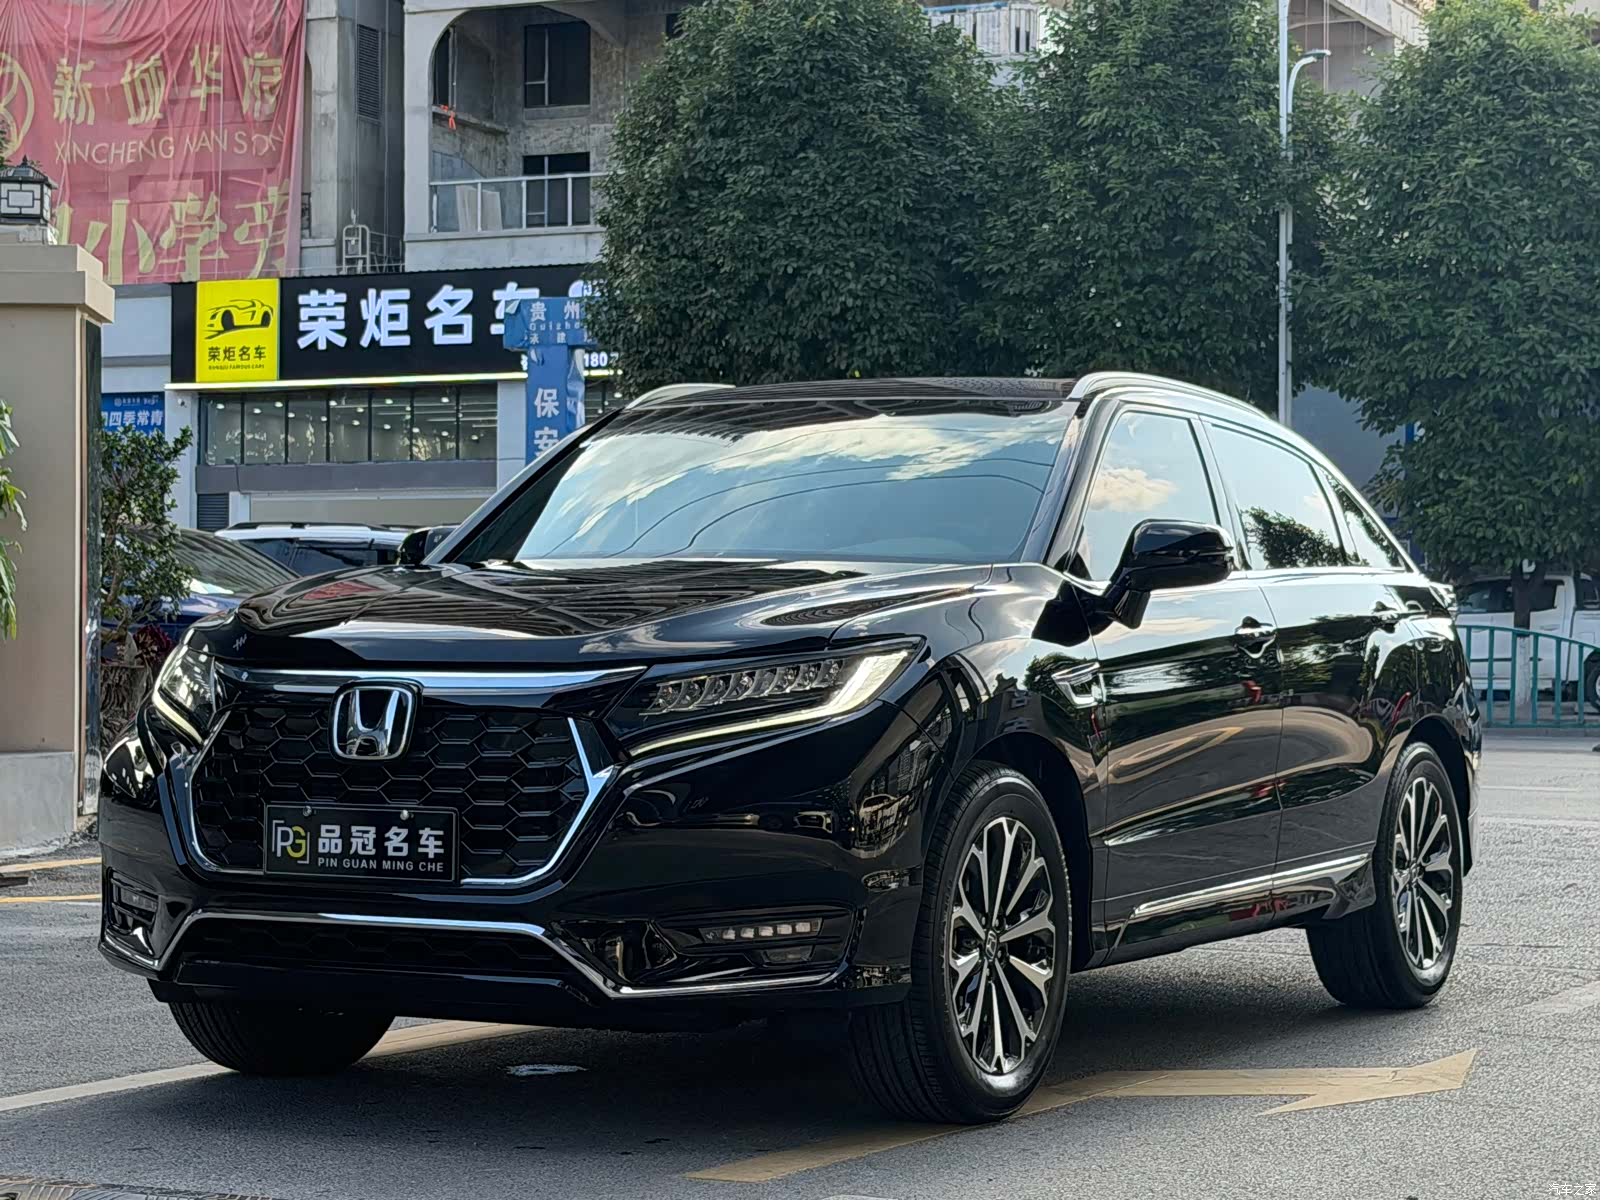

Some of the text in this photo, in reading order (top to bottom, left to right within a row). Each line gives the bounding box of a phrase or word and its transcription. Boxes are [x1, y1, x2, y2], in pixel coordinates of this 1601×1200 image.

[55, 135, 174, 165] XINCHENG
[207, 345, 267, 362] 荣炬名车
[317, 824, 445, 860] 品冠名车
[317, 857, 445, 873] PIN GUAN MING CHE
